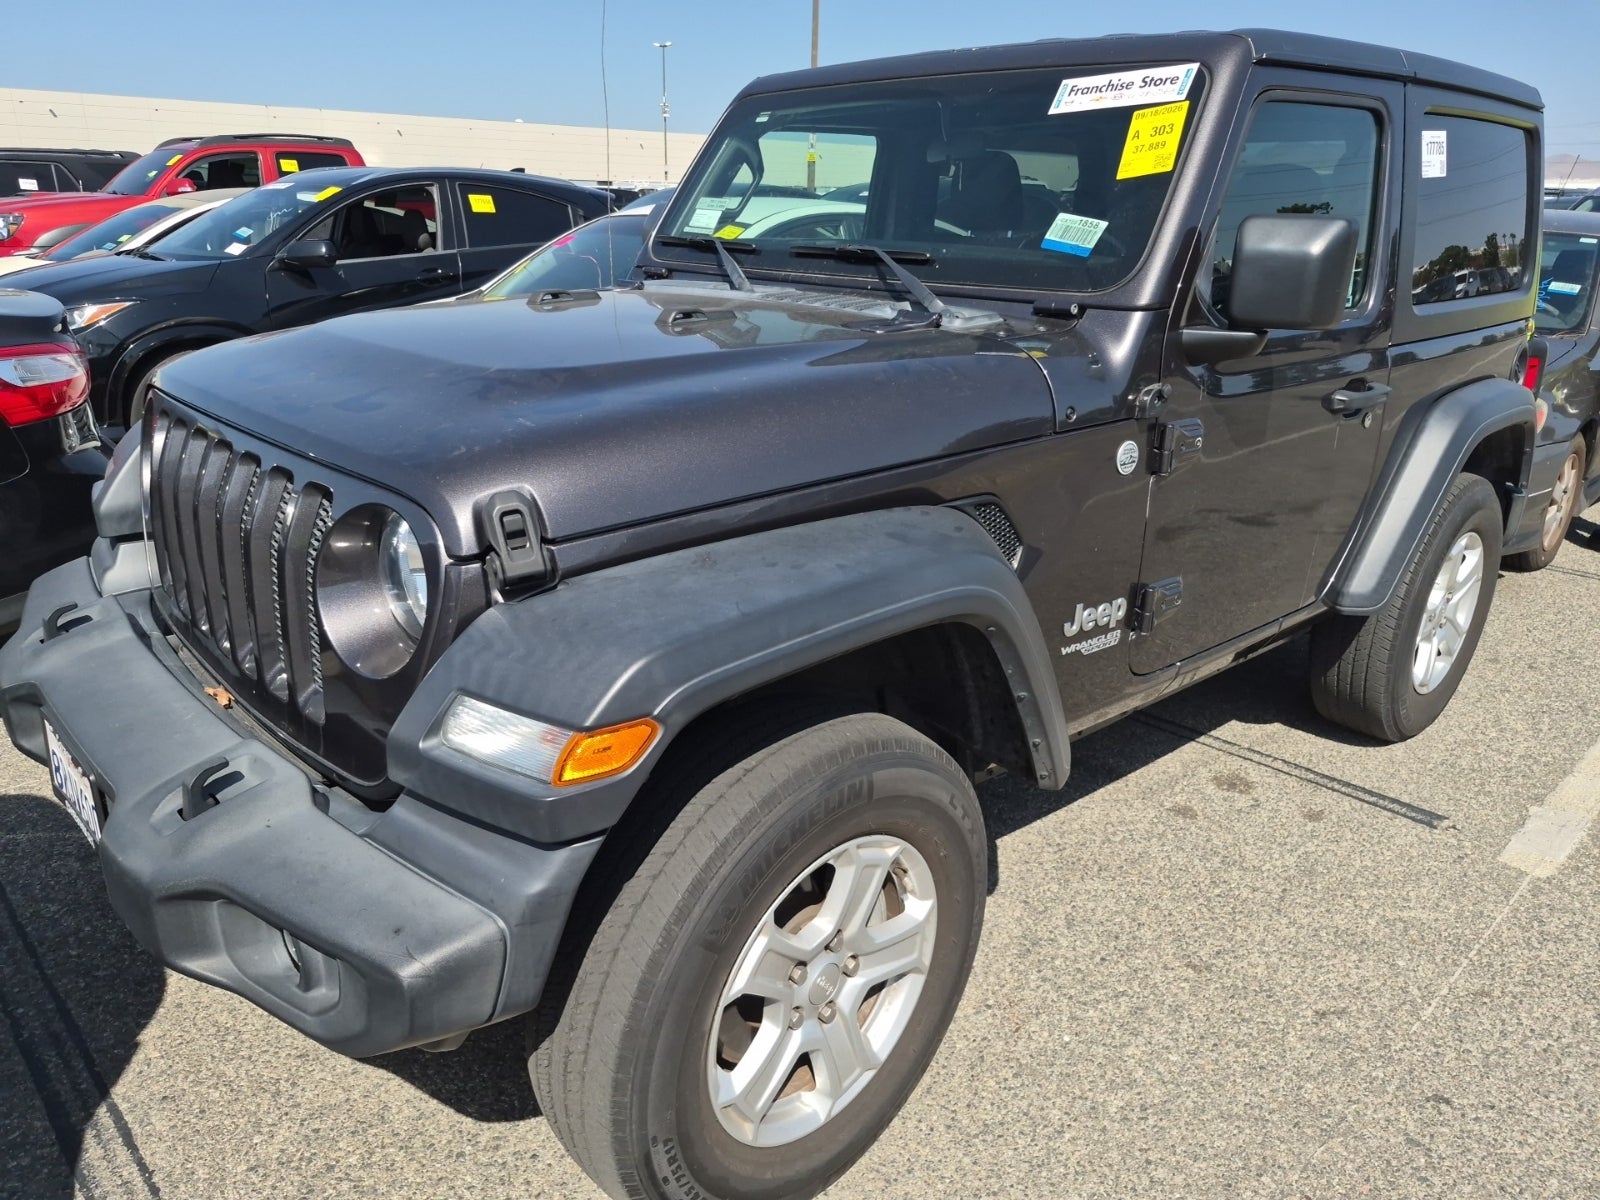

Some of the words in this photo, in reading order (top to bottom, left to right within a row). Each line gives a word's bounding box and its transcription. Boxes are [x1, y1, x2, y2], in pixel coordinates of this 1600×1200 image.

[1067, 78, 1134, 97] Franchise
[1138, 74, 1180, 89] Store
[1131, 130, 1141, 141] A
[1149, 123, 1175, 138] 303
[1063, 597, 1127, 637] Jeep
[1061, 630, 1121, 656] WRANGLER
